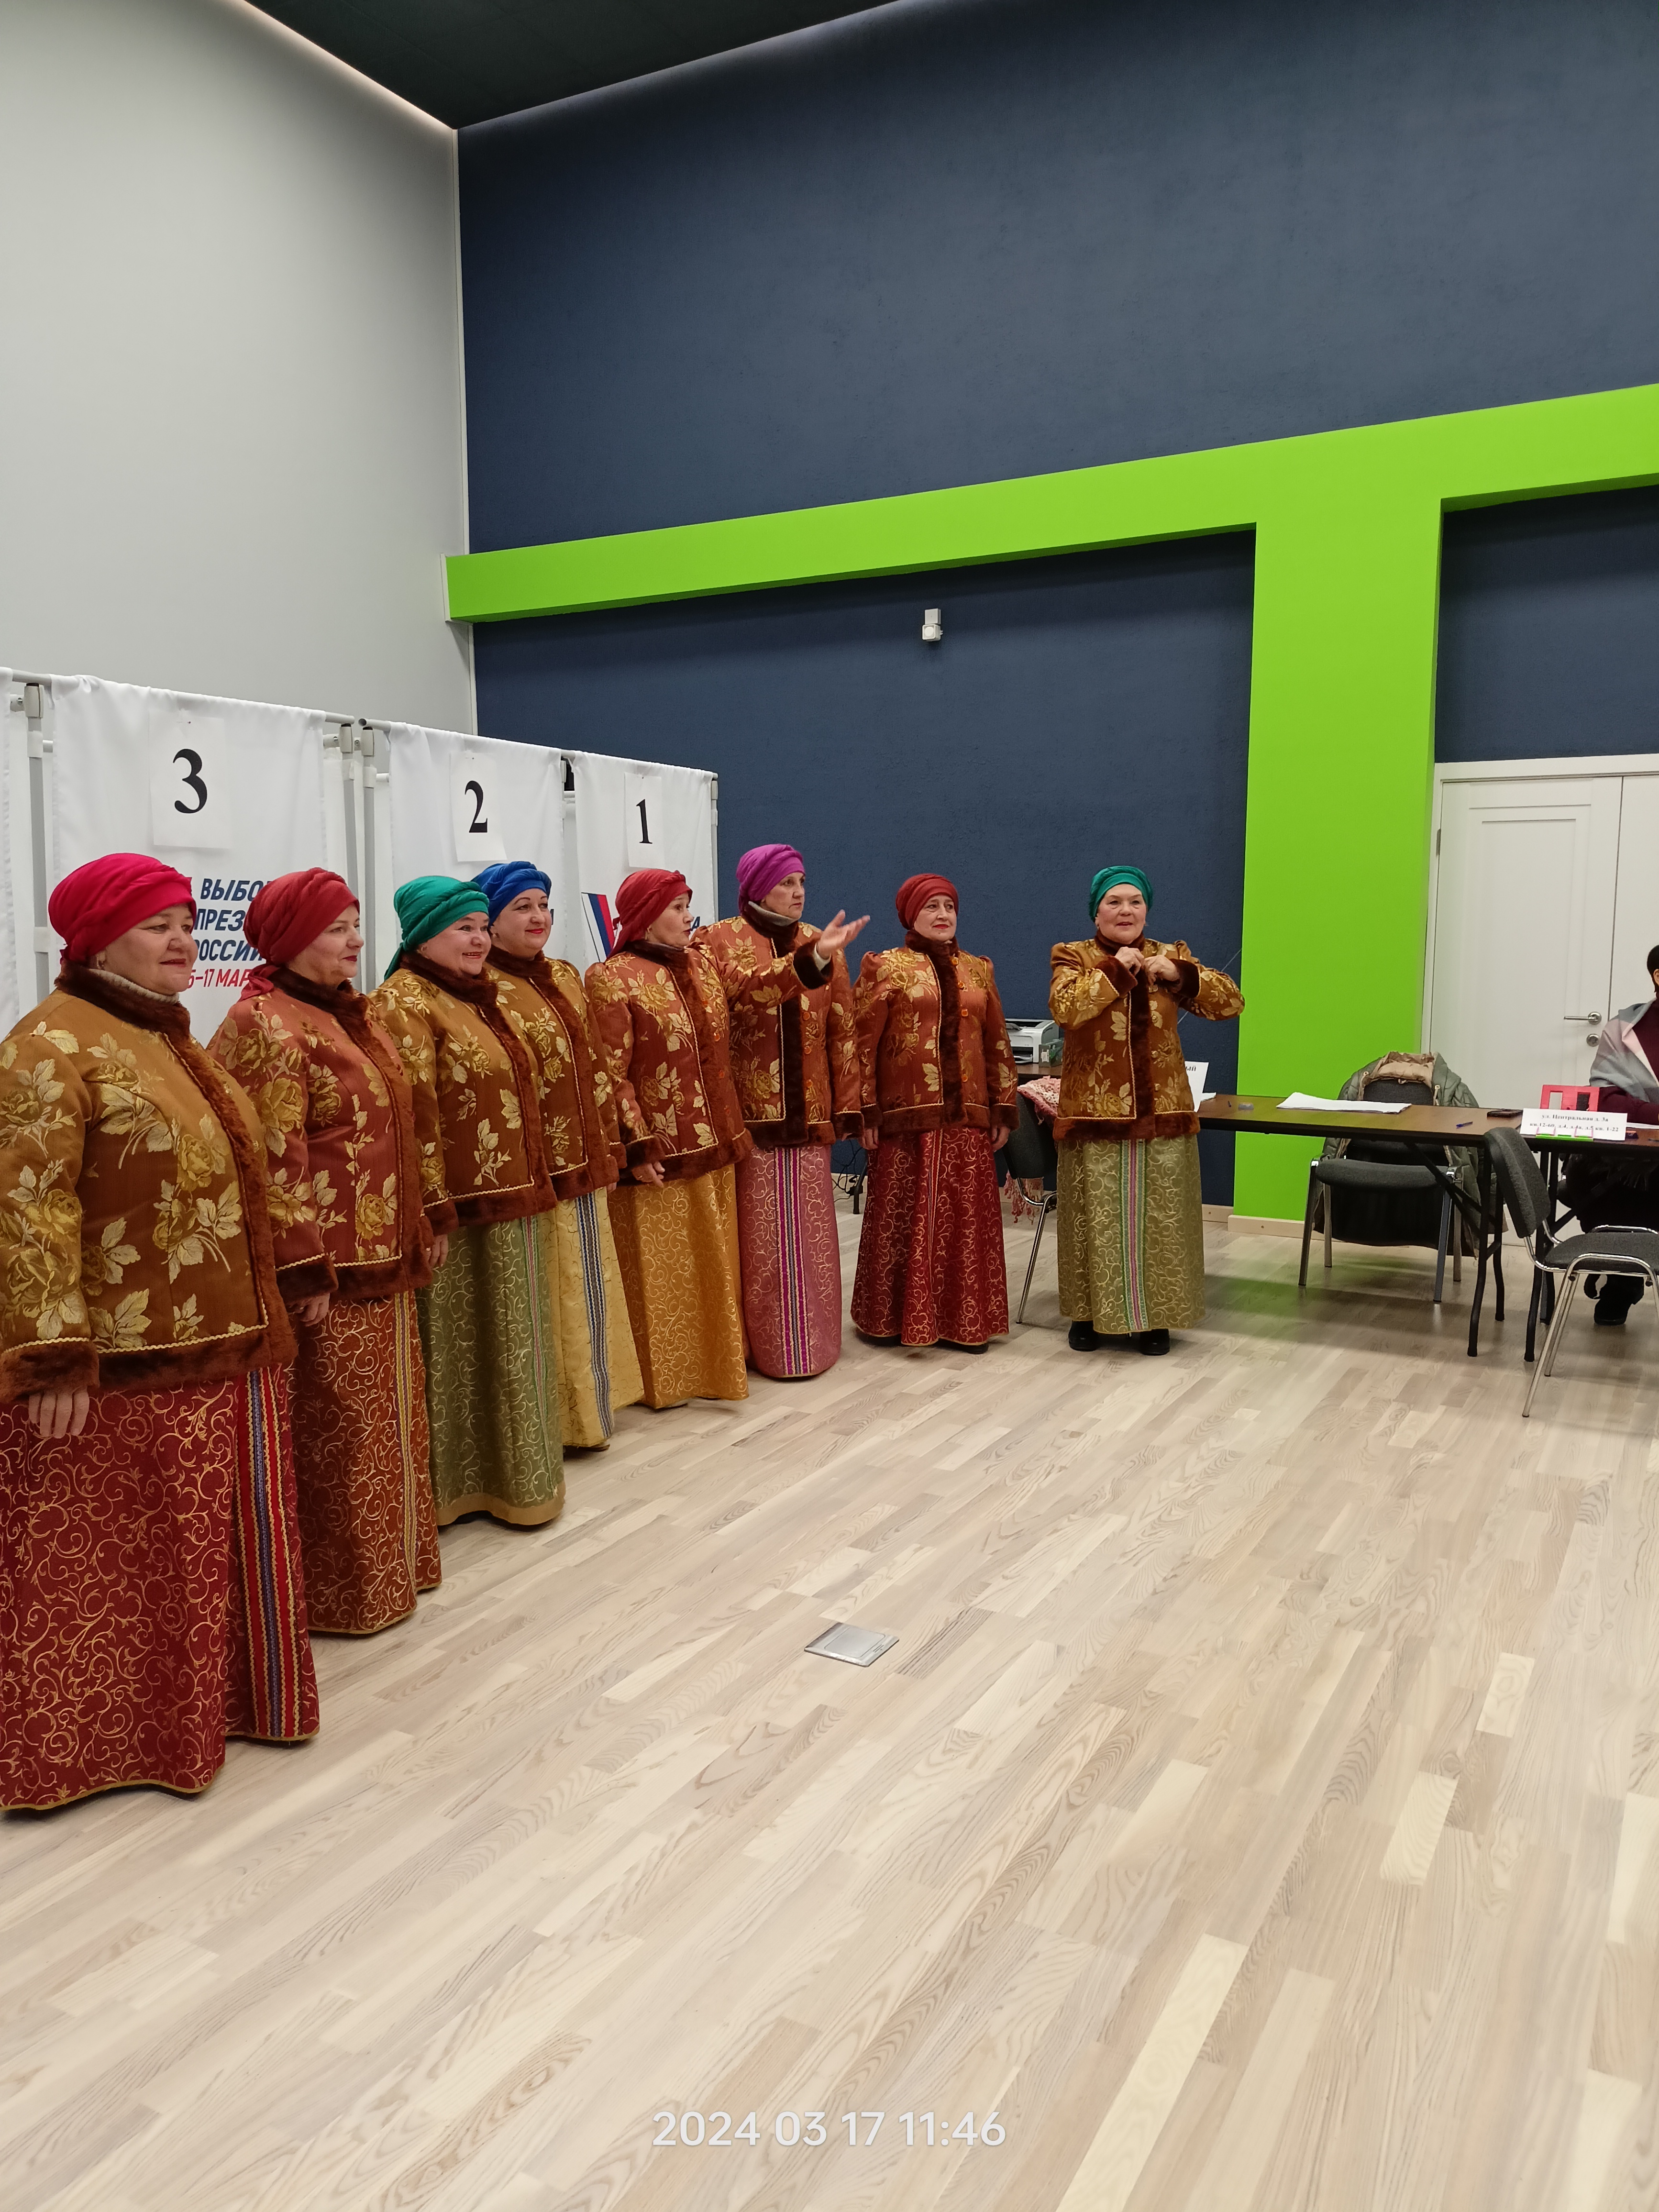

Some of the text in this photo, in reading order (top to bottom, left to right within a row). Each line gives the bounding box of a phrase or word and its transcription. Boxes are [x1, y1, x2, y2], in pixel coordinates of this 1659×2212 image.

[172, 748, 208, 814] 3
[465, 780, 488, 833] 2
[636, 799, 653, 844] 1
[200, 878, 272, 902] ВЫБО
[194, 908, 244, 931] ПРЕЗ
